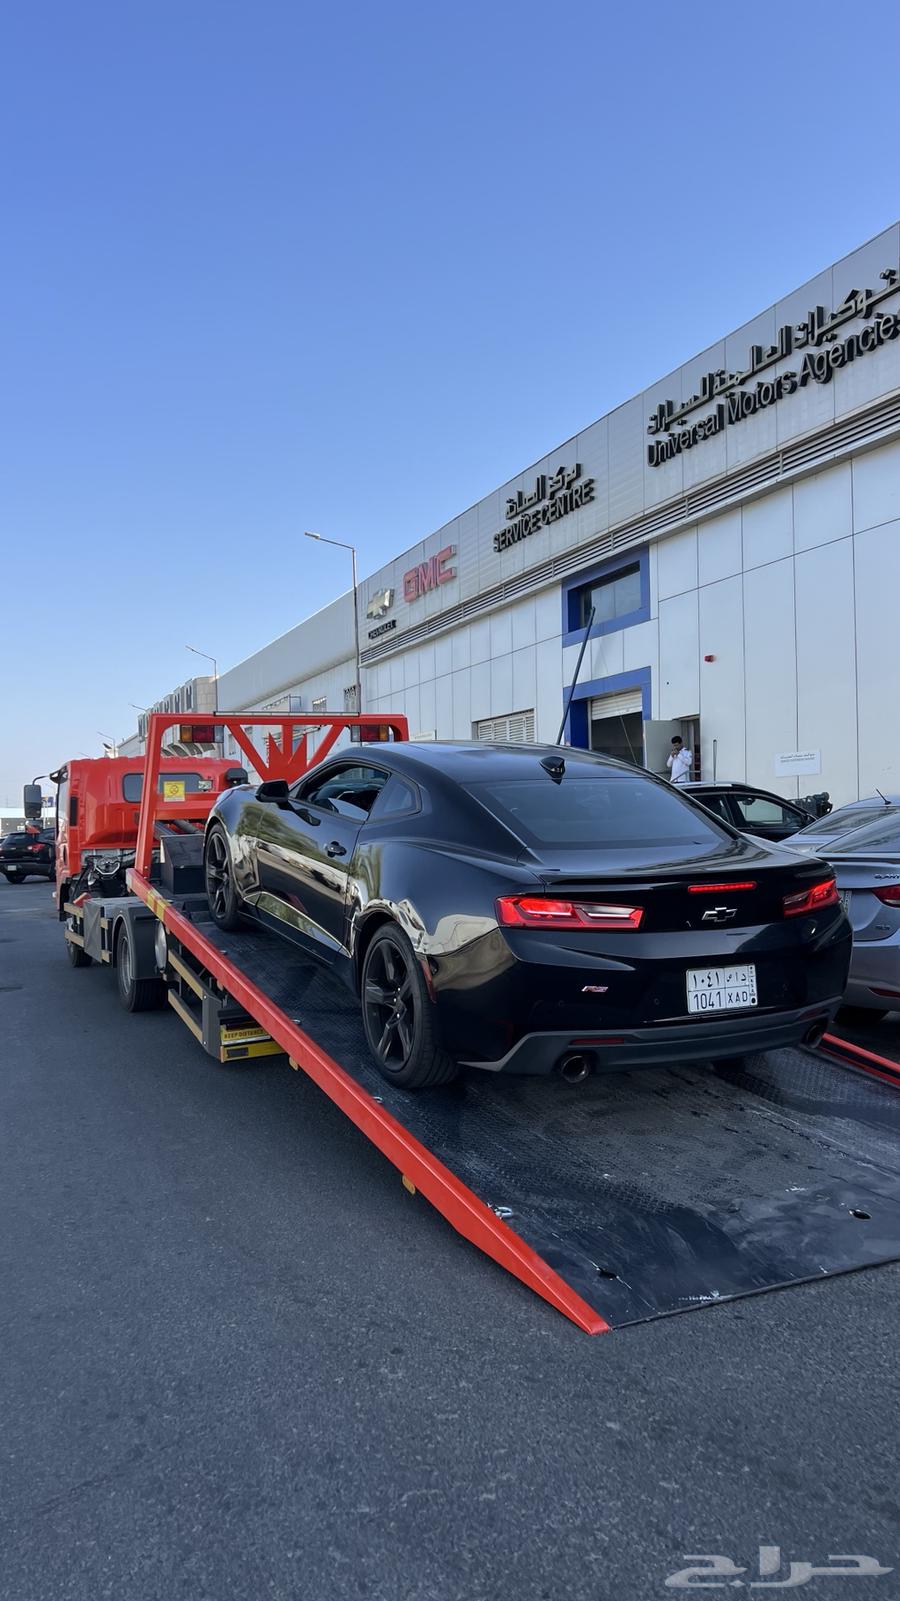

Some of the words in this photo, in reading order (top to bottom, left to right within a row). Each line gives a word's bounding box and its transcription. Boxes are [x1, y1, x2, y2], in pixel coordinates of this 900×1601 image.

[648, 403, 725, 467] Universal
[726, 371, 797, 425] Motors
[548, 463, 582, 501] مركز
[493, 510, 542, 552] SERVICE
[541, 478, 595, 526] CENTRE
[403, 544, 456, 603] GMC
[693, 990, 722, 1011] 1041
[727, 990, 748, 1004] XAD
